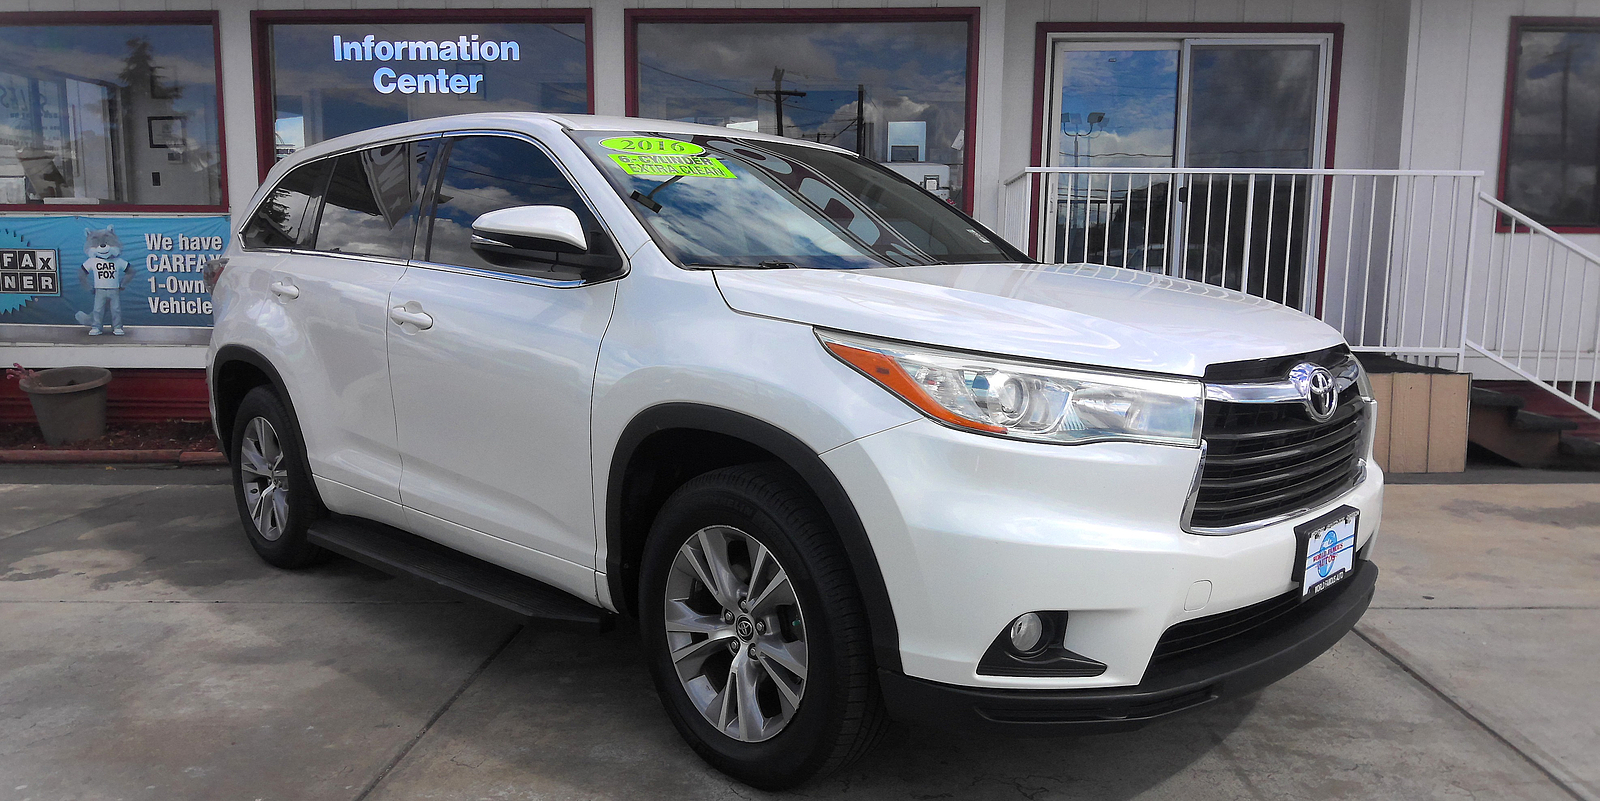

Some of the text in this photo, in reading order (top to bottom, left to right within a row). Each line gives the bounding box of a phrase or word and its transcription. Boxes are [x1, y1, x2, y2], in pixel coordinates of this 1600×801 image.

[333, 35, 520, 61] Information
[373, 67, 484, 94] Center
[621, 140, 685, 152] 2016
[628, 164, 726, 177] EXTRA CLEAN
[144, 233, 222, 250] We have
[96, 262, 115, 271] CAR
[98, 270, 115, 279] FOX
